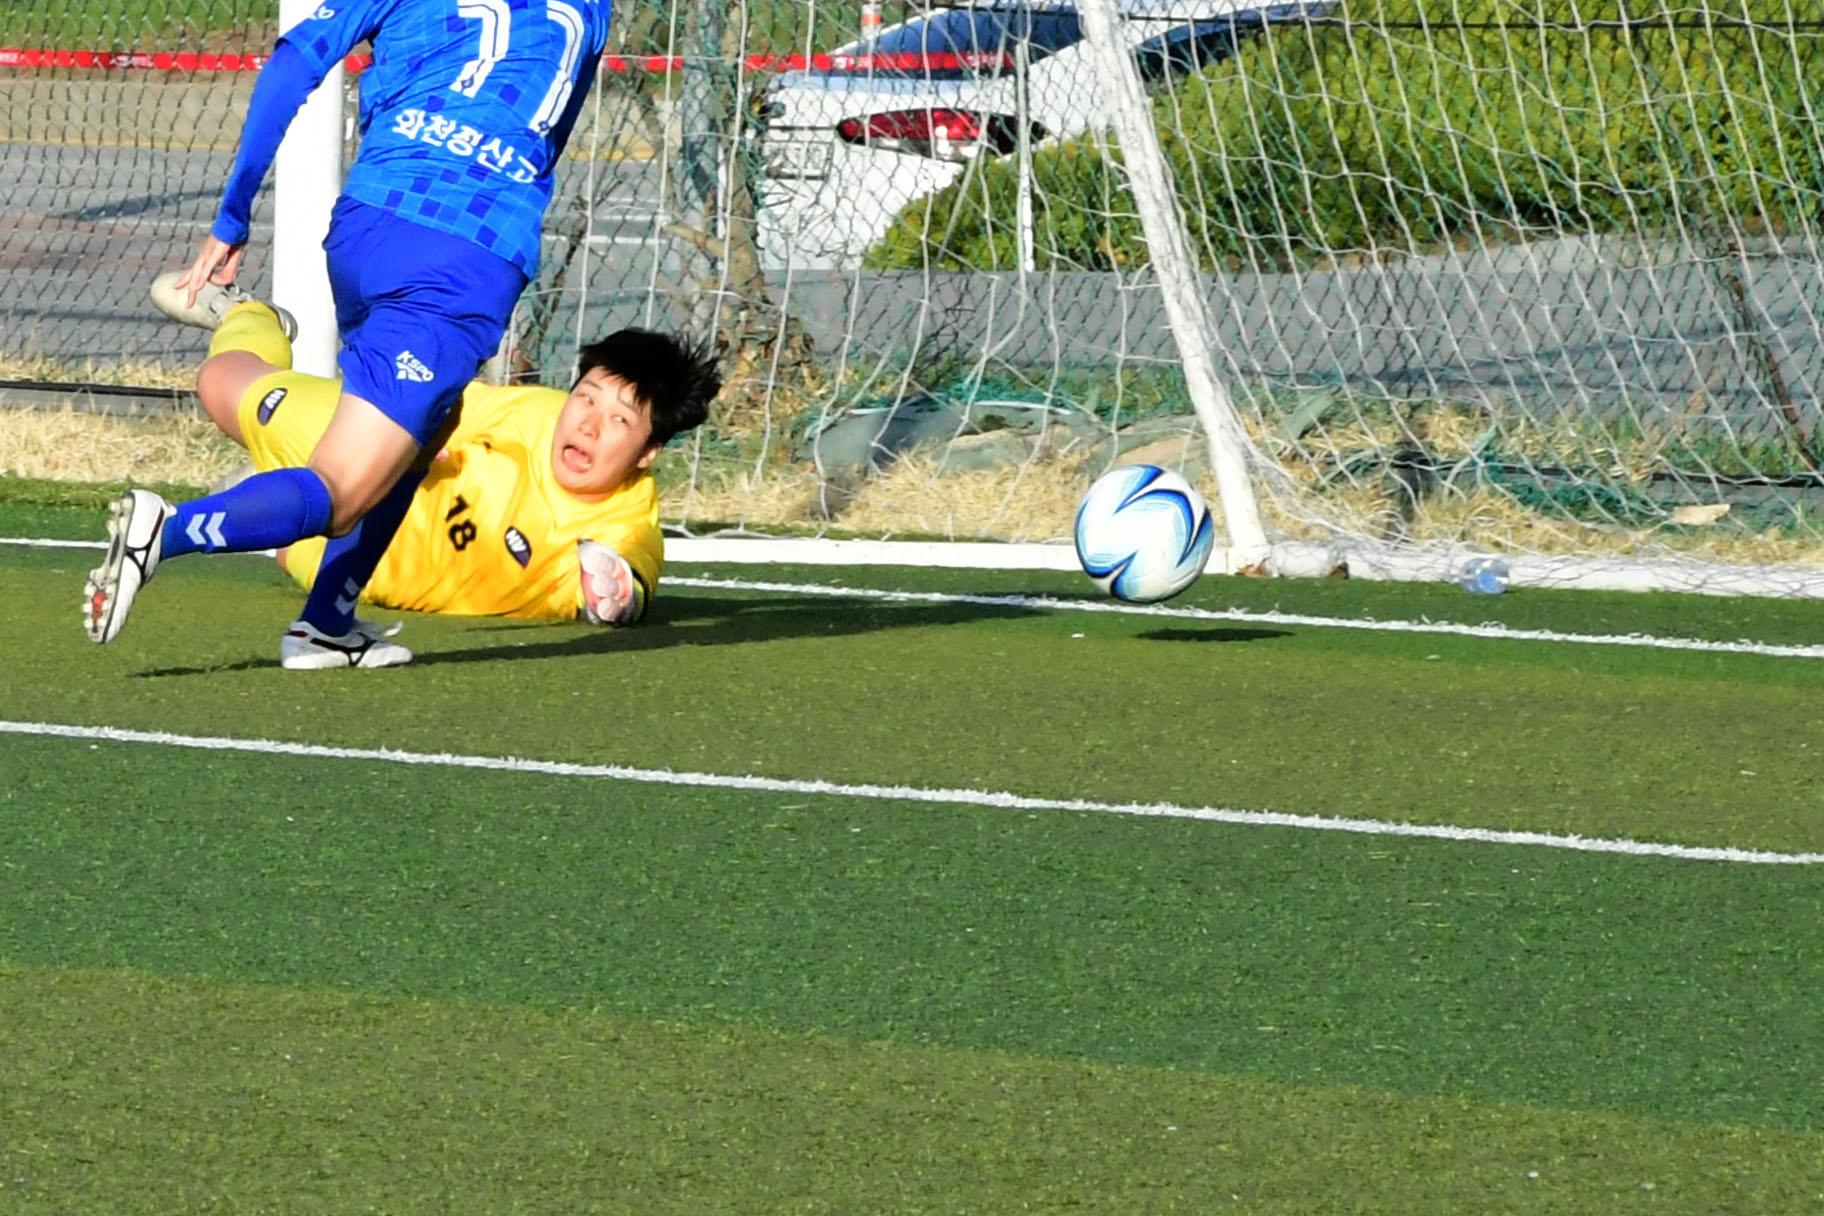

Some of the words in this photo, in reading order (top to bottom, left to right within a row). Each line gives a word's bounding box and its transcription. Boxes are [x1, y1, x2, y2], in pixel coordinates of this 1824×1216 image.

[392, 109, 538, 184] 화천정산고
[396, 350, 435, 382] KSPO
[445, 493, 477, 553] 18
